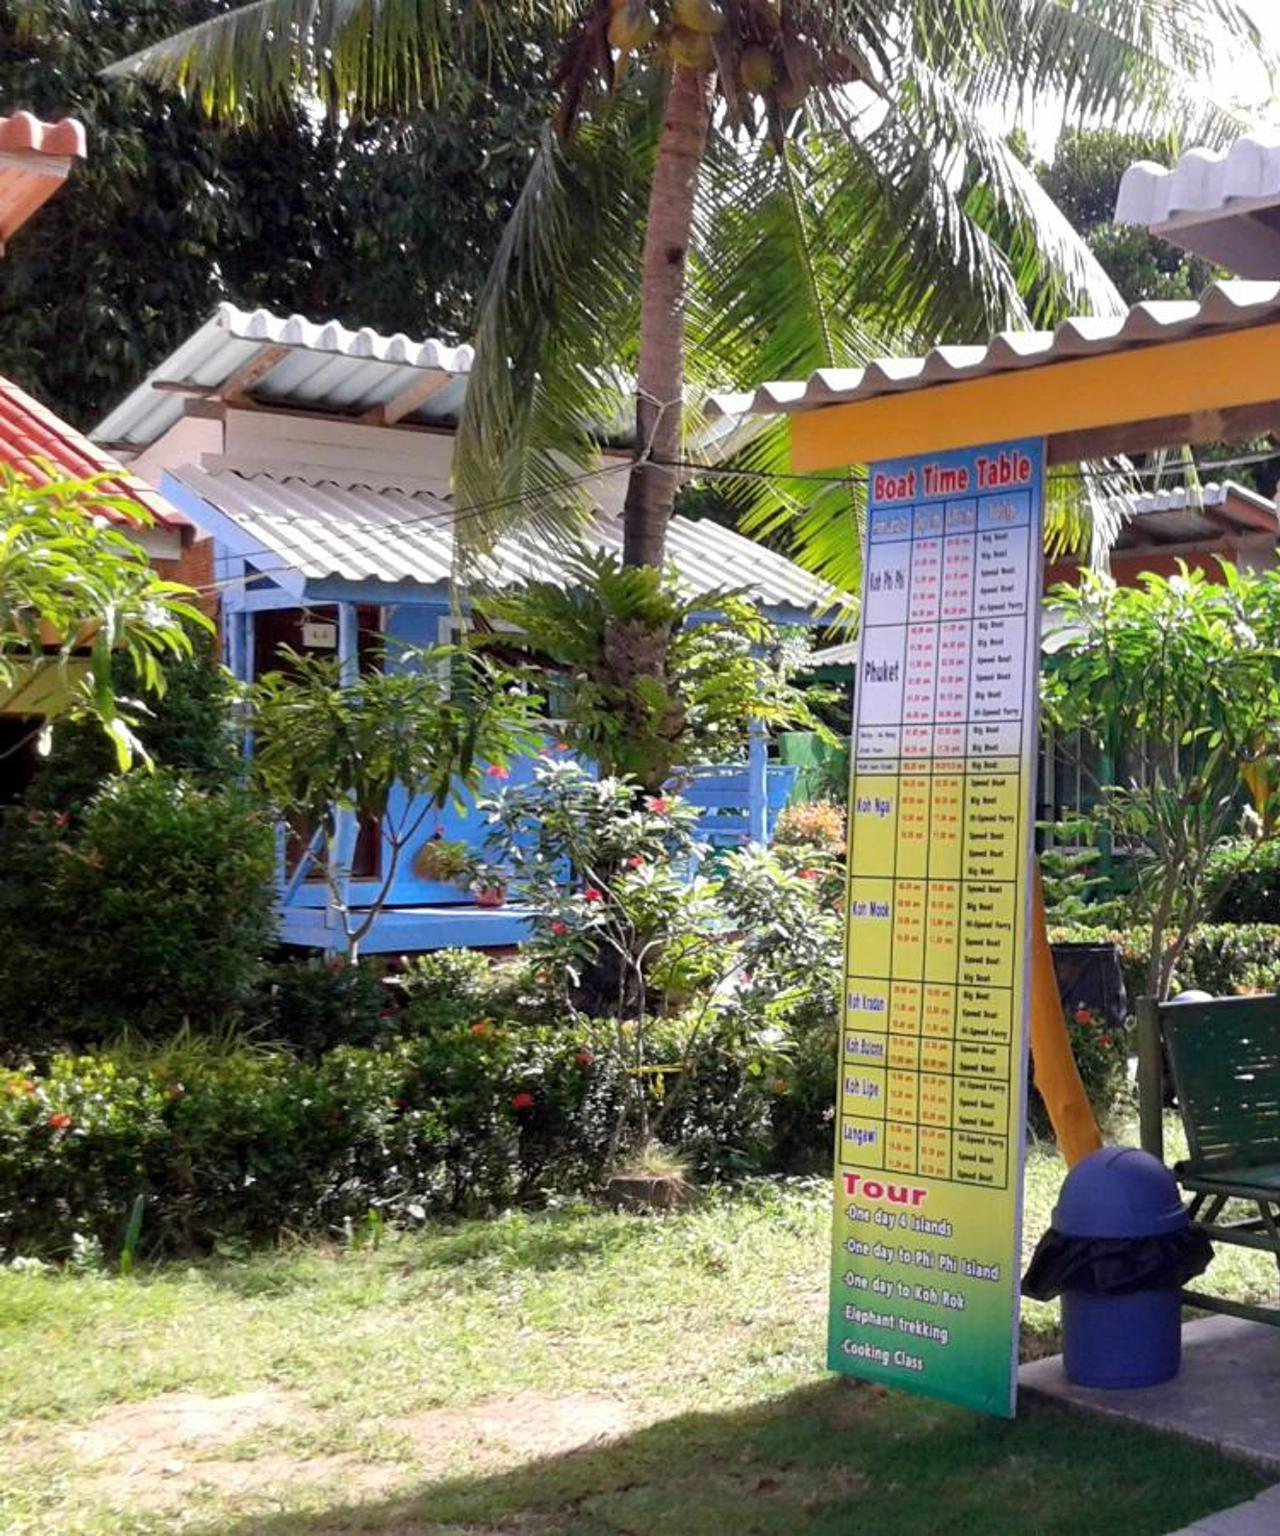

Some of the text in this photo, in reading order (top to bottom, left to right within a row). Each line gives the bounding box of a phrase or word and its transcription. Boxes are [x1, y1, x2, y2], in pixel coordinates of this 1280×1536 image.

[874, 452, 1031, 500] Boat Time Table
[865, 659, 899, 683] Phuket
[843, 1172, 927, 1205] Tour
[874, 1208, 896, 1230] day
[899, 1211, 908, 1227] 4
[873, 1241, 894, 1266] day
[898, 1246, 911, 1264] to
[939, 1253, 958, 1273] Phi
[872, 1275, 894, 1299] day
[897, 1280, 909, 1298] to
[914, 1284, 938, 1303] Koh
[942, 1290, 965, 1310] Rok
[899, 1316, 949, 1345] trekking
[893, 1350, 924, 1371] Class
